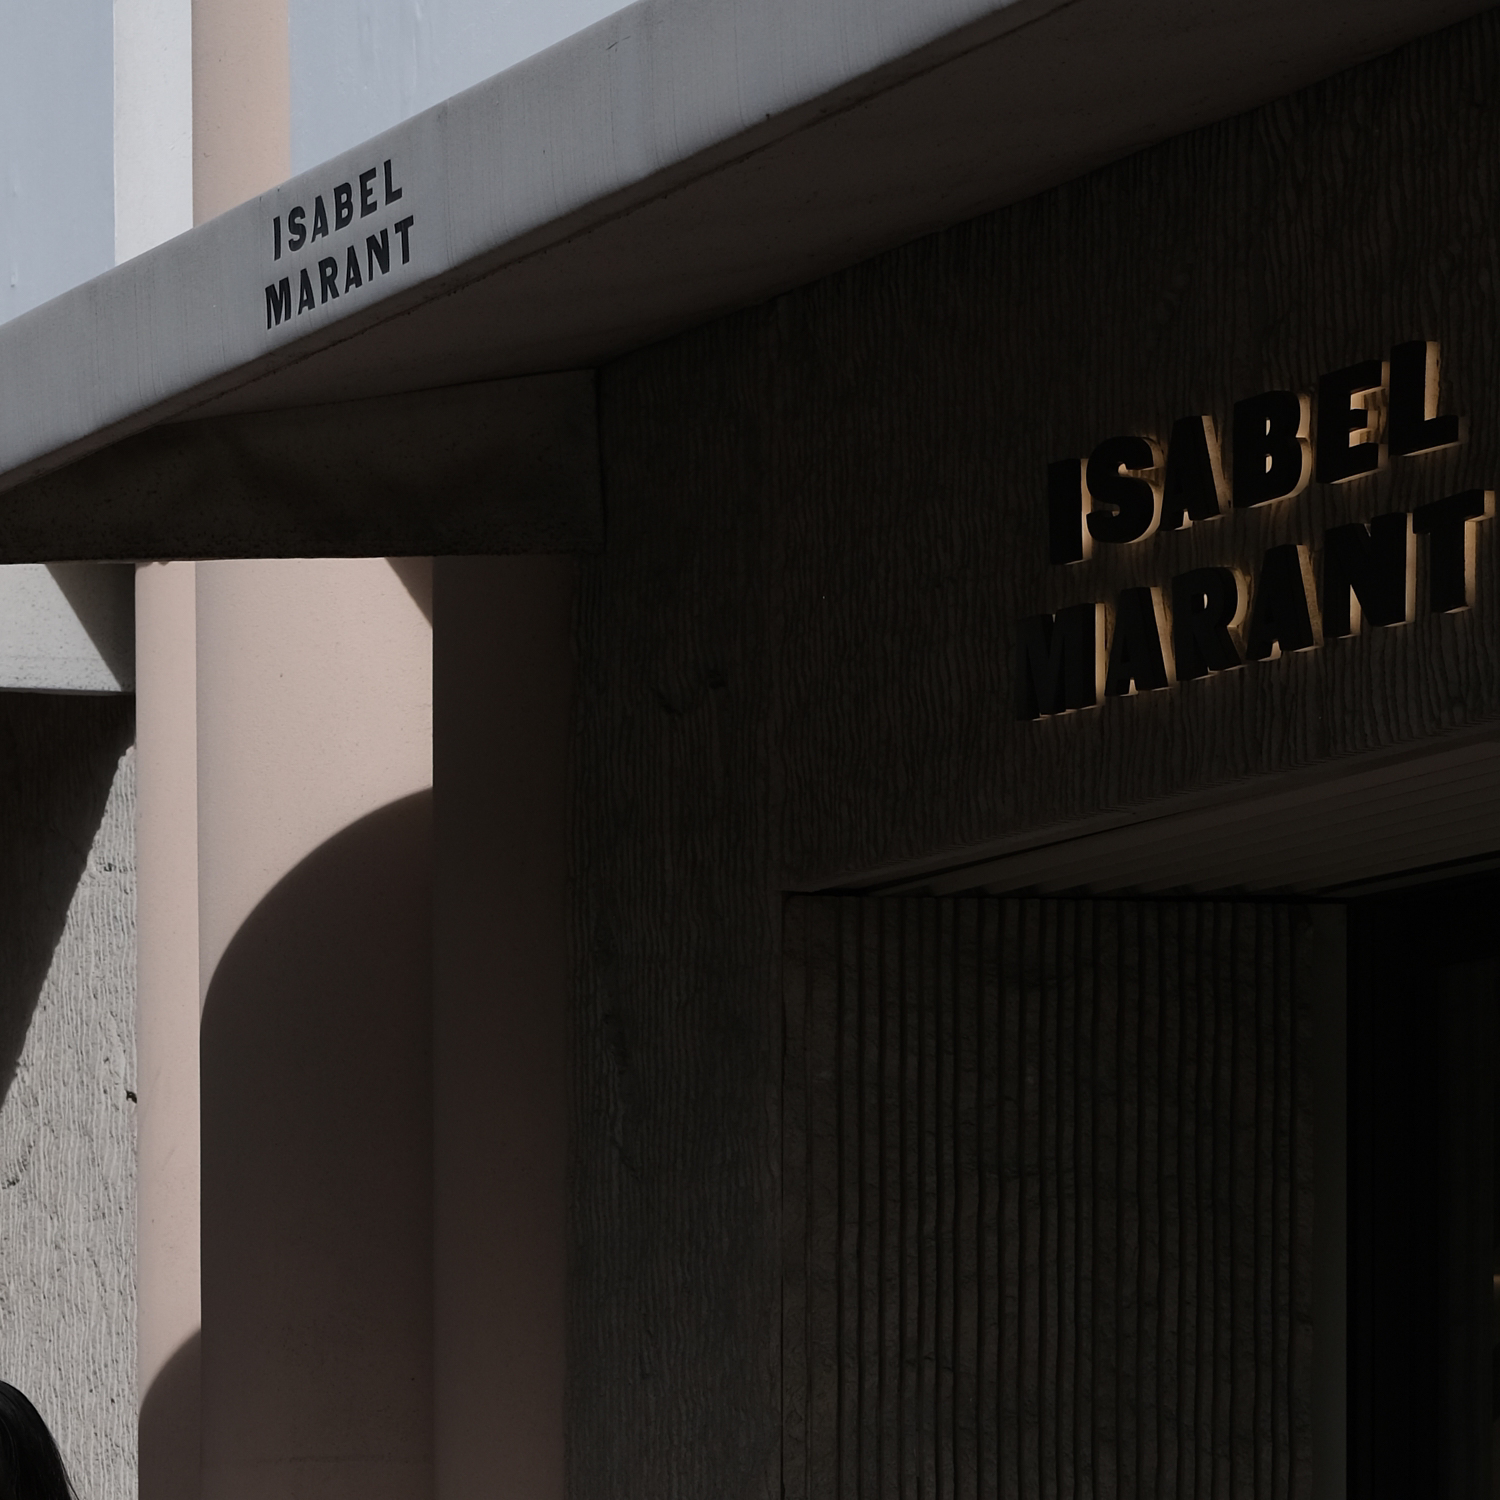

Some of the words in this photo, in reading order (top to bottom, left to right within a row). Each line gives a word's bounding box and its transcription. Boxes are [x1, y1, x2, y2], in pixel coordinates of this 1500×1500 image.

[265, 215, 414, 330] MARANT
[273, 159, 402, 261] ISABEL
[1048, 340, 1466, 565] ISABEL
[1016, 489, 1494, 721] MARANT
